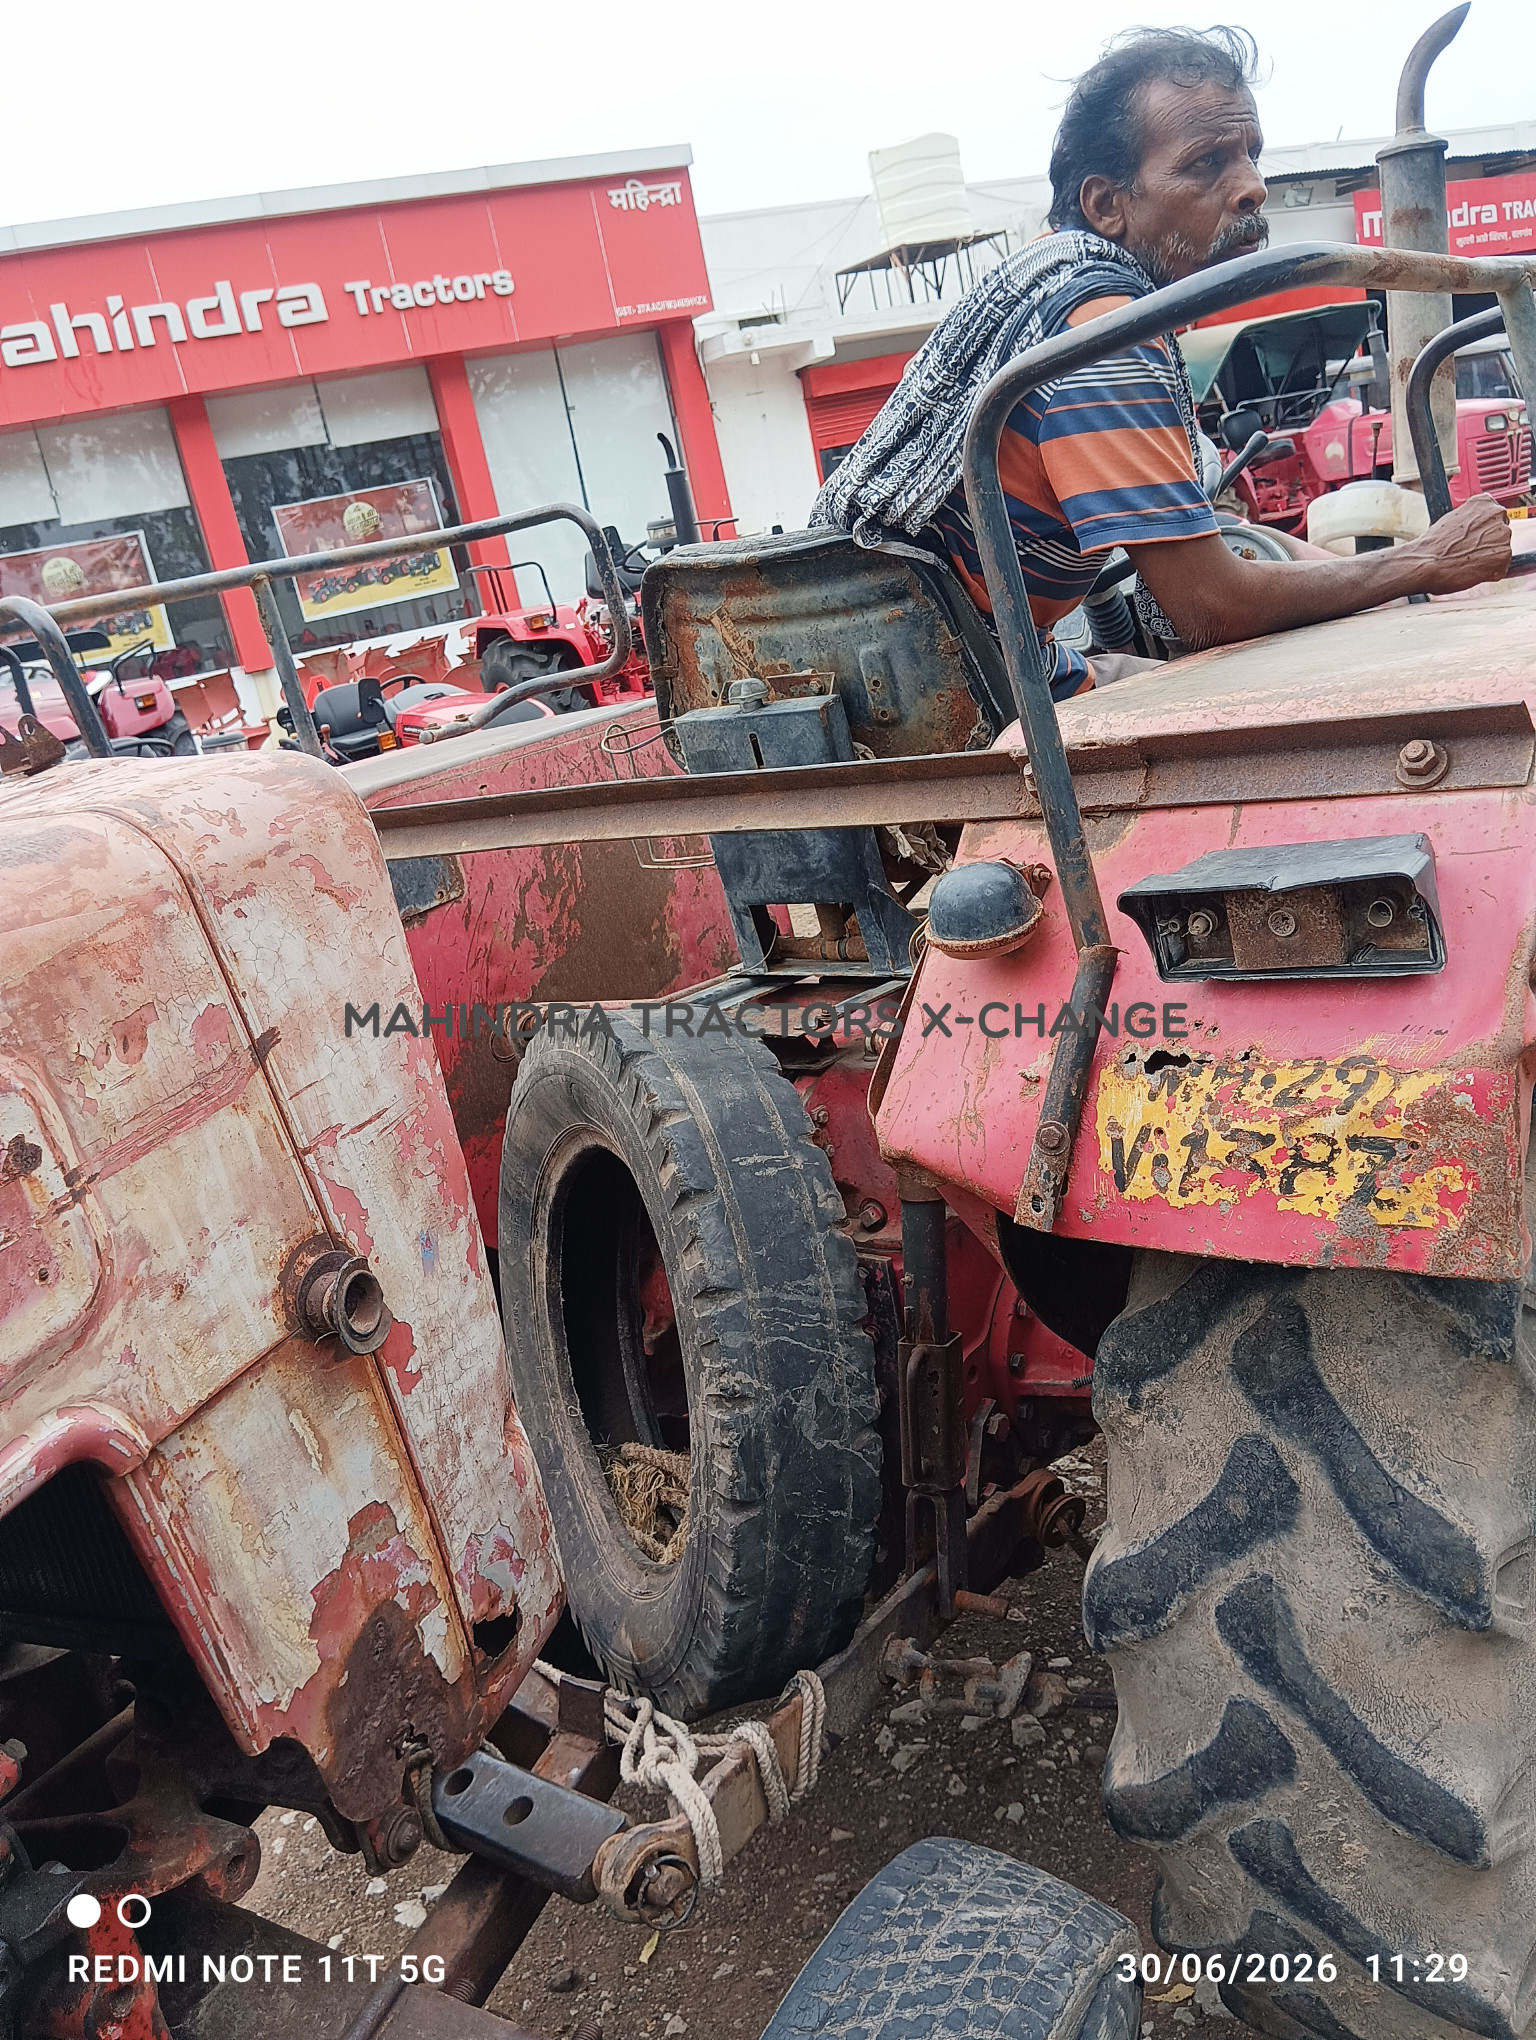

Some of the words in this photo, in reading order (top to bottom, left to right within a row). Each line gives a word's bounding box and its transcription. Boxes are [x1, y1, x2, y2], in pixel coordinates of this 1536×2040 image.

[607, 179, 682, 211] महिन्द्रा
[1362, 201, 1498, 238] mdra
[1501, 199, 1536, 220] TRA
[344, 269, 516, 316] Tractors
